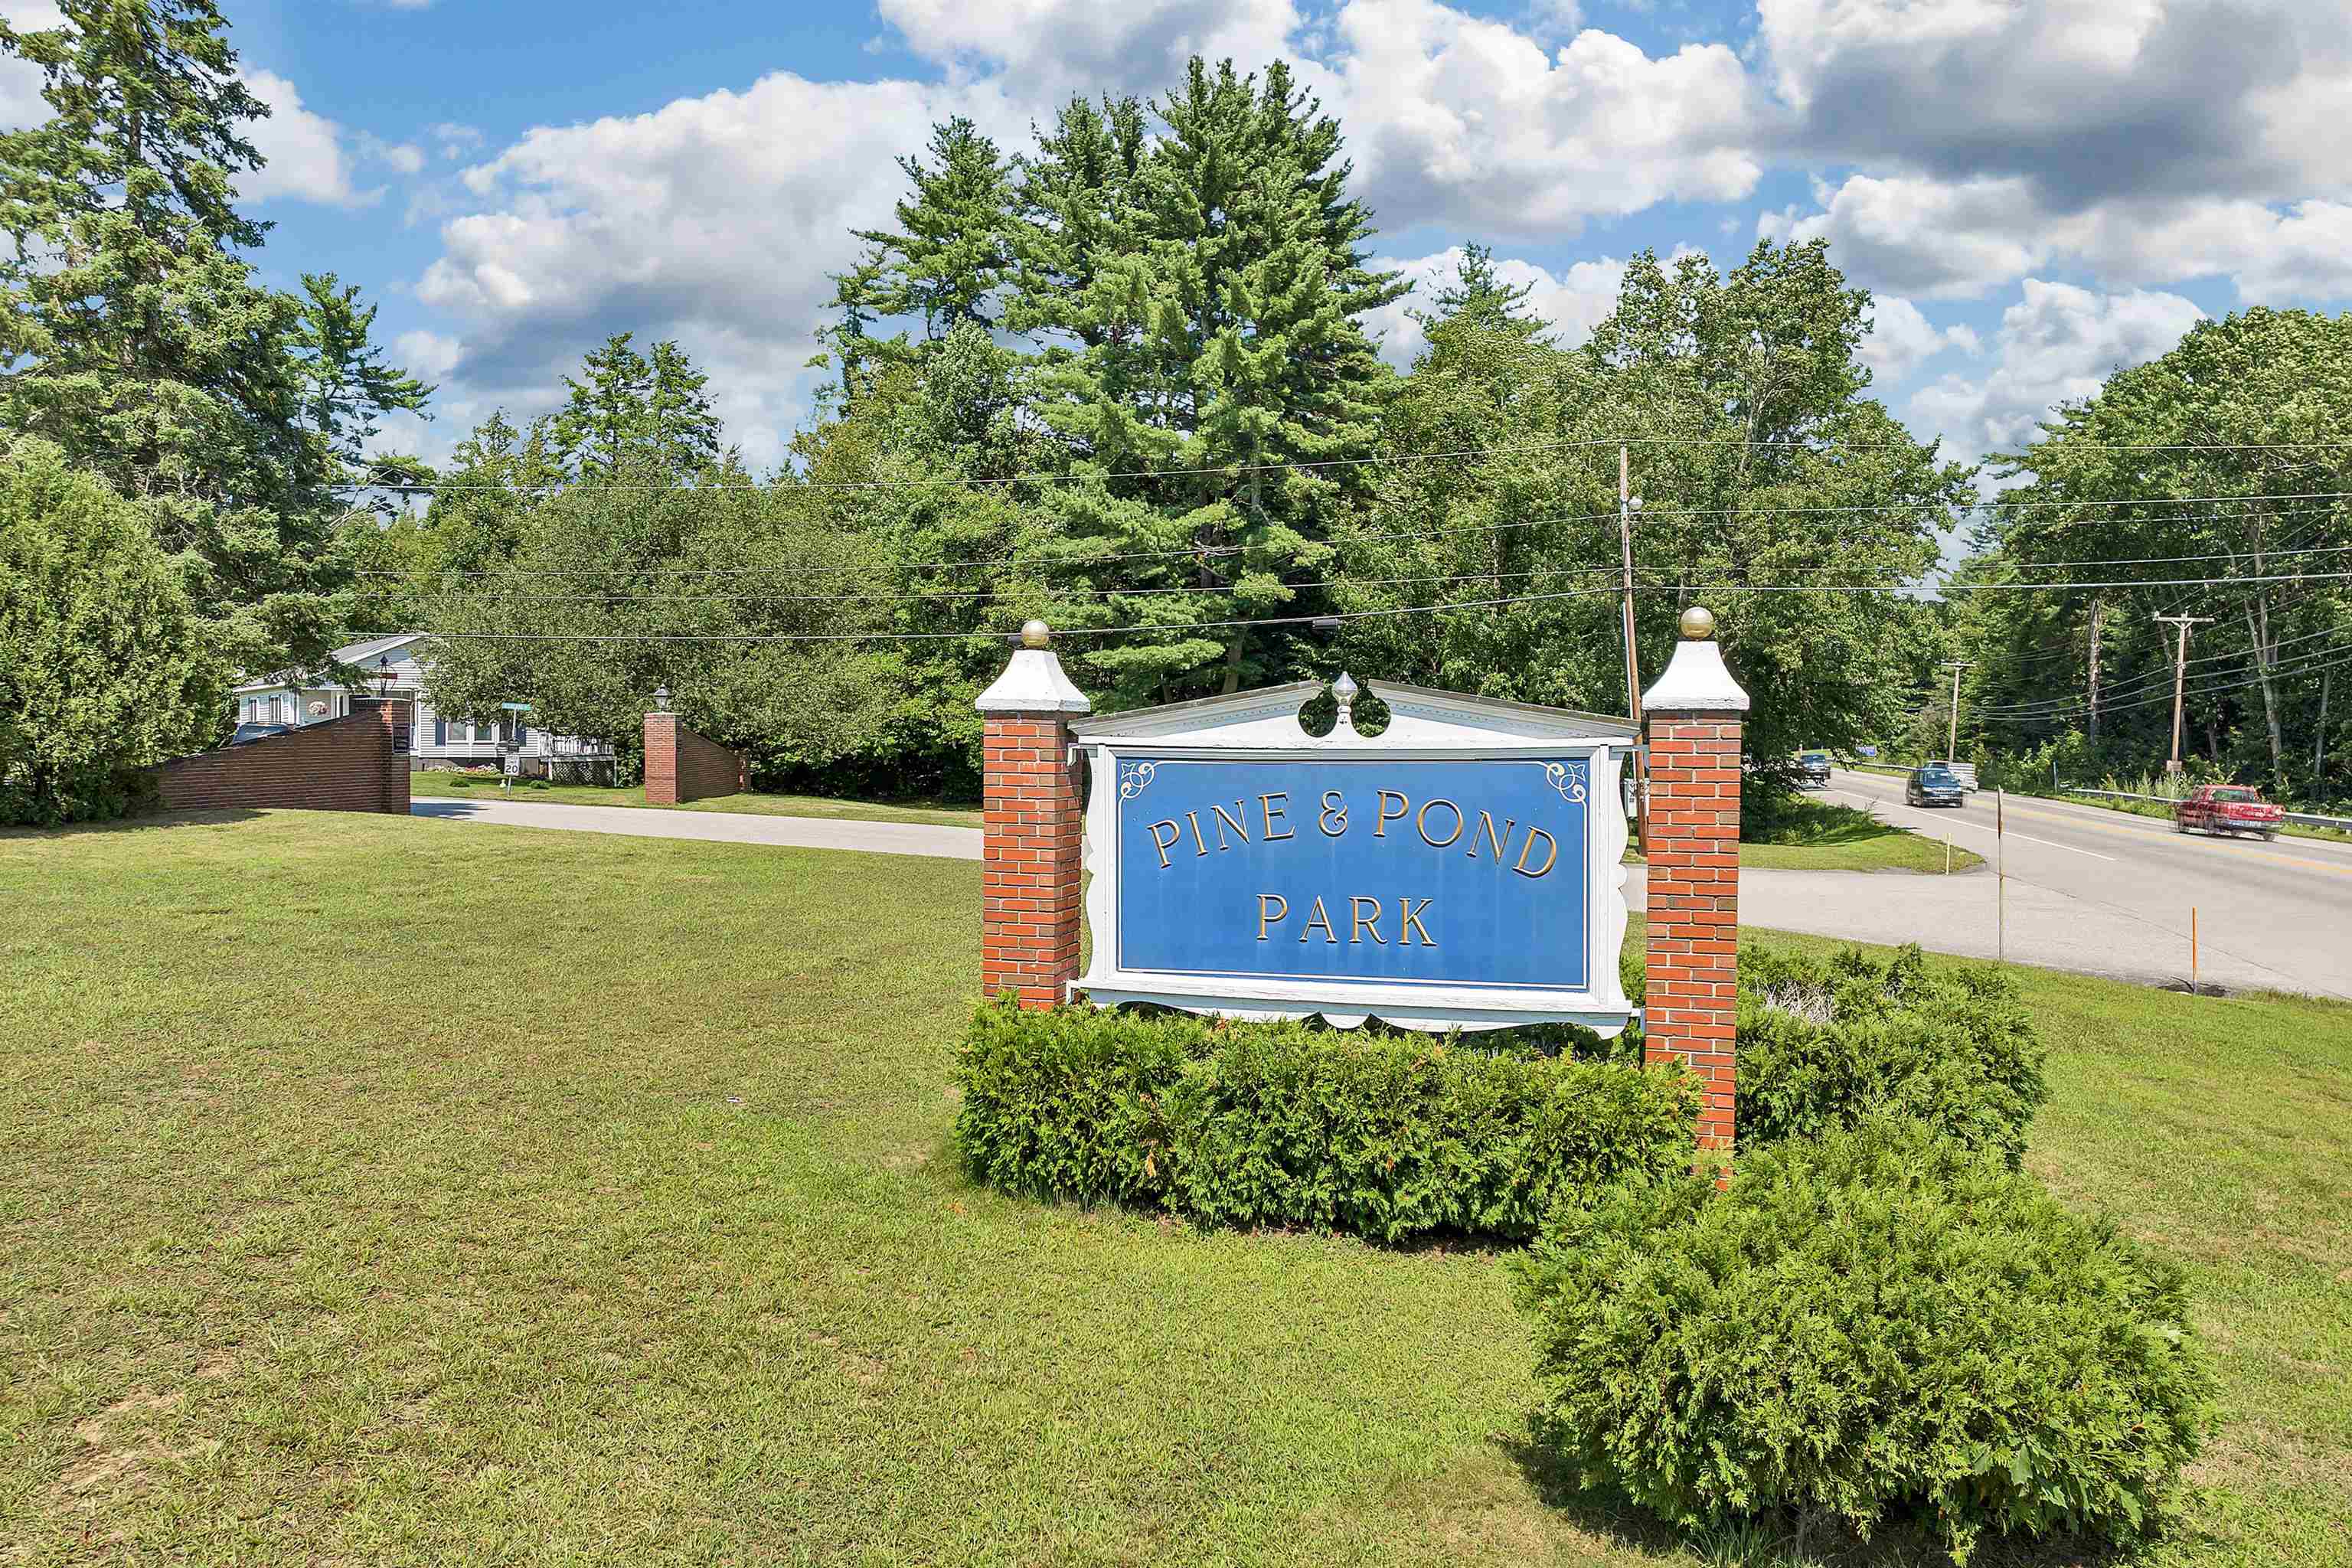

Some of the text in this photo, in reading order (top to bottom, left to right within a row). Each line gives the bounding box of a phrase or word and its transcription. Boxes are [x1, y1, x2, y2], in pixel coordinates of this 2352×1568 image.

[505, 765, 518, 773] 20
[1147, 789, 1559, 879] PINE & POND
[1256, 893, 1438, 947] PARK
